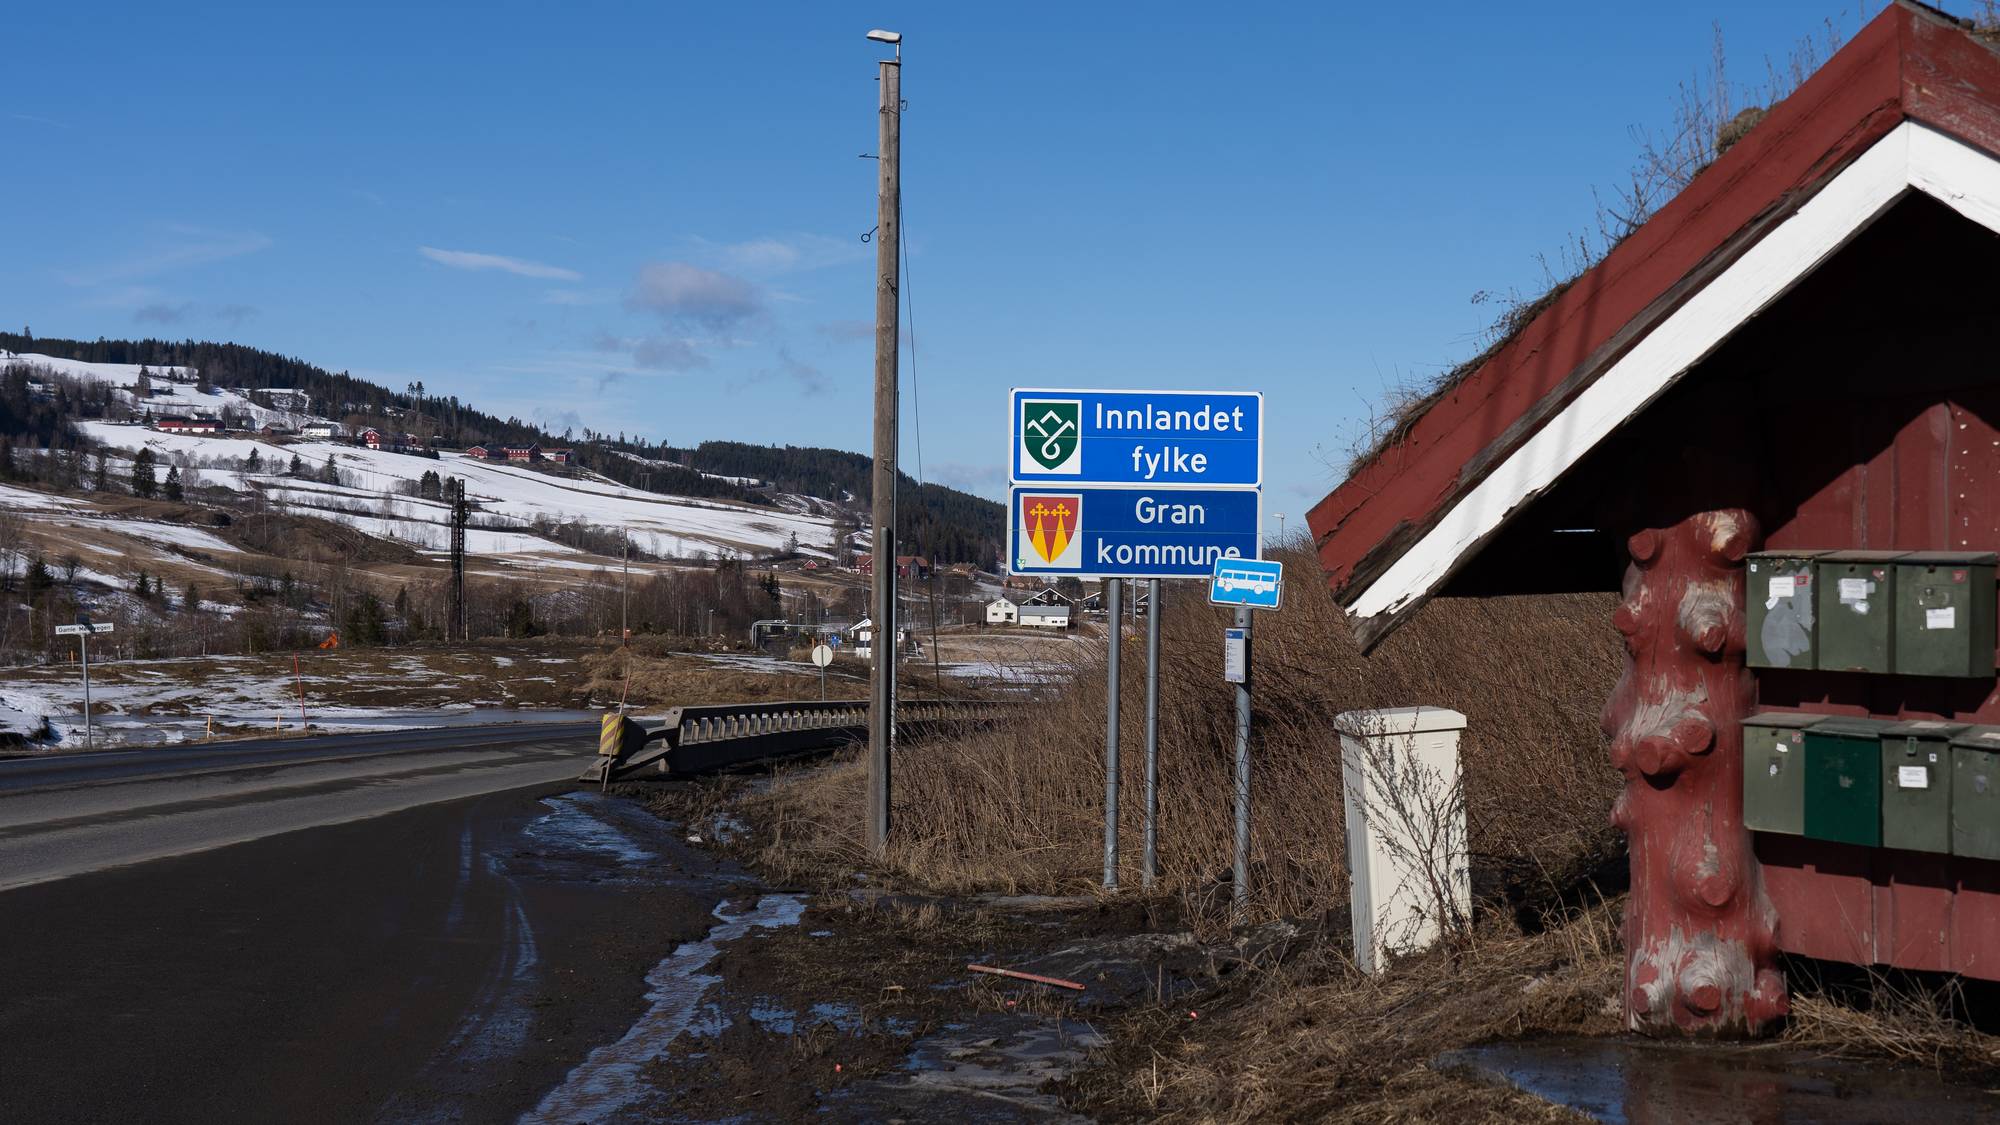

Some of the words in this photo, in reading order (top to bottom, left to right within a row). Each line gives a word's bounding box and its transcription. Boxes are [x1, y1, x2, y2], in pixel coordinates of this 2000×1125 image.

[1096, 402, 1244, 432] Innlandet
[1132, 445, 1207, 480] fylke
[1135, 496, 1205, 524] Gran
[1097, 538, 1241, 566] kommune
